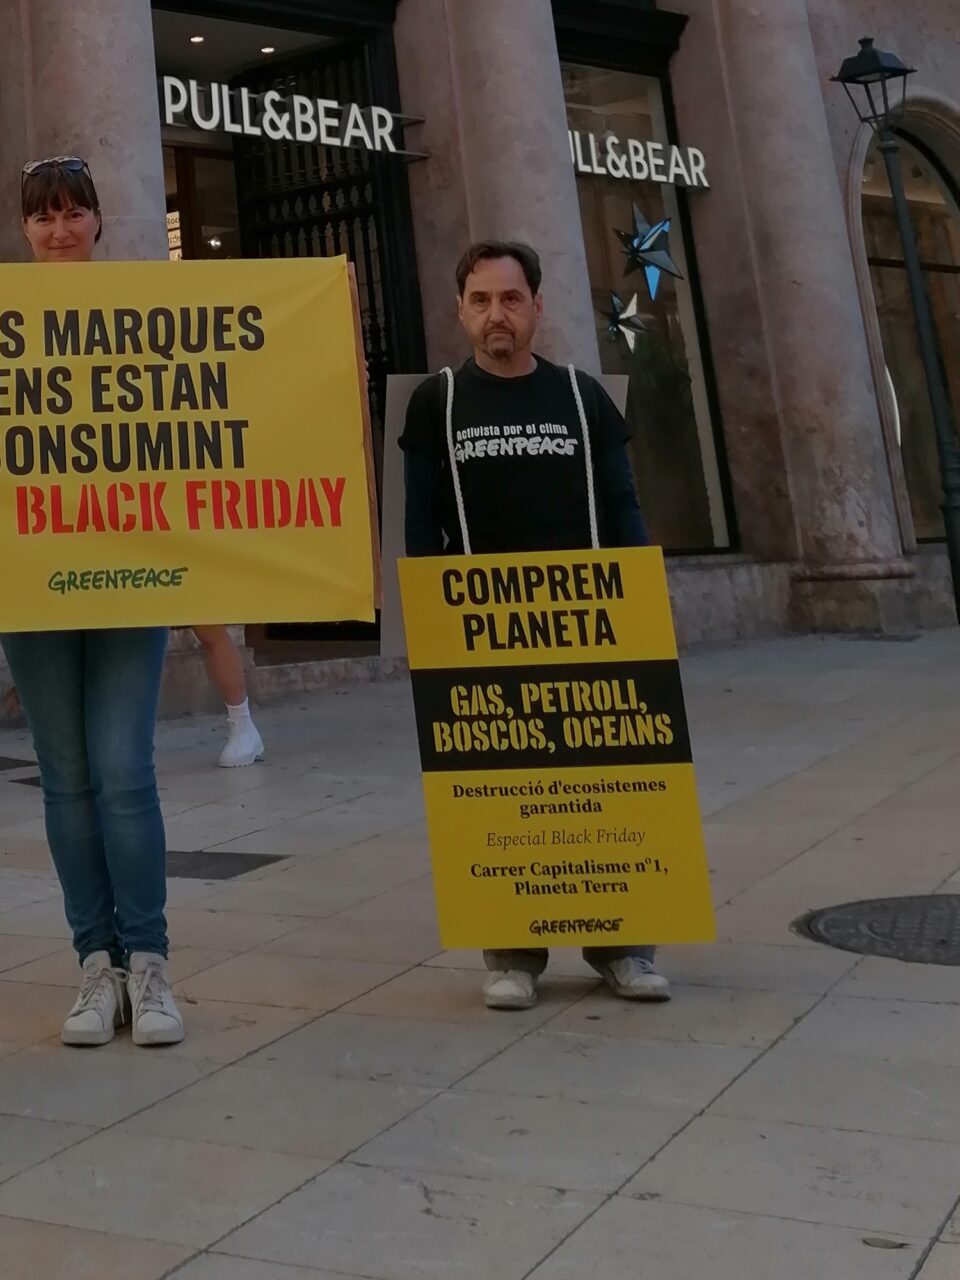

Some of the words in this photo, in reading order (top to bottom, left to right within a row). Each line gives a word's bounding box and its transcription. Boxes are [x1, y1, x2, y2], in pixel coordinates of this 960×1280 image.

[163, 75, 397, 152] PULL&BEAR
[568, 131, 710, 187] LL&BEAR
[44, 305, 264, 361] MARQUES
[91, 362, 228, 412] ESTAN
[456, 426, 500, 441] Activista
[503, 426, 522, 436] por
[526, 424, 536, 434] el
[540, 423, 568, 434] clima
[454, 436, 578, 463] GREENPEACE
[16, 482, 170, 534] BLACK
[186, 478, 345, 529] FRIDAY
[48, 567, 188, 594] GREENPEACE
[442, 562, 623, 606] COMPREM
[463, 609, 616, 651] PLANETA
[451, 684, 514, 719] GAS,
[521, 679, 647, 714] PETROLI,
[433, 718, 555, 753] BOSCOS,
[563, 714, 673, 748] OCEANS
[453, 780, 544, 798] Destrucció
[548, 779, 666, 795] d'ecosistemes
[520, 799, 602, 818] garantida
[487, 830, 546, 851] Especial
[551, 829, 591, 845] Black
[596, 828, 645, 846] Friday
[471, 864, 526, 877] Carrer
[530, 860, 630, 879] Capitalisme
[515, 881, 578, 895] Planeta
[581, 880, 628, 893] Terra
[529, 918, 623, 936] GREENPEACE
